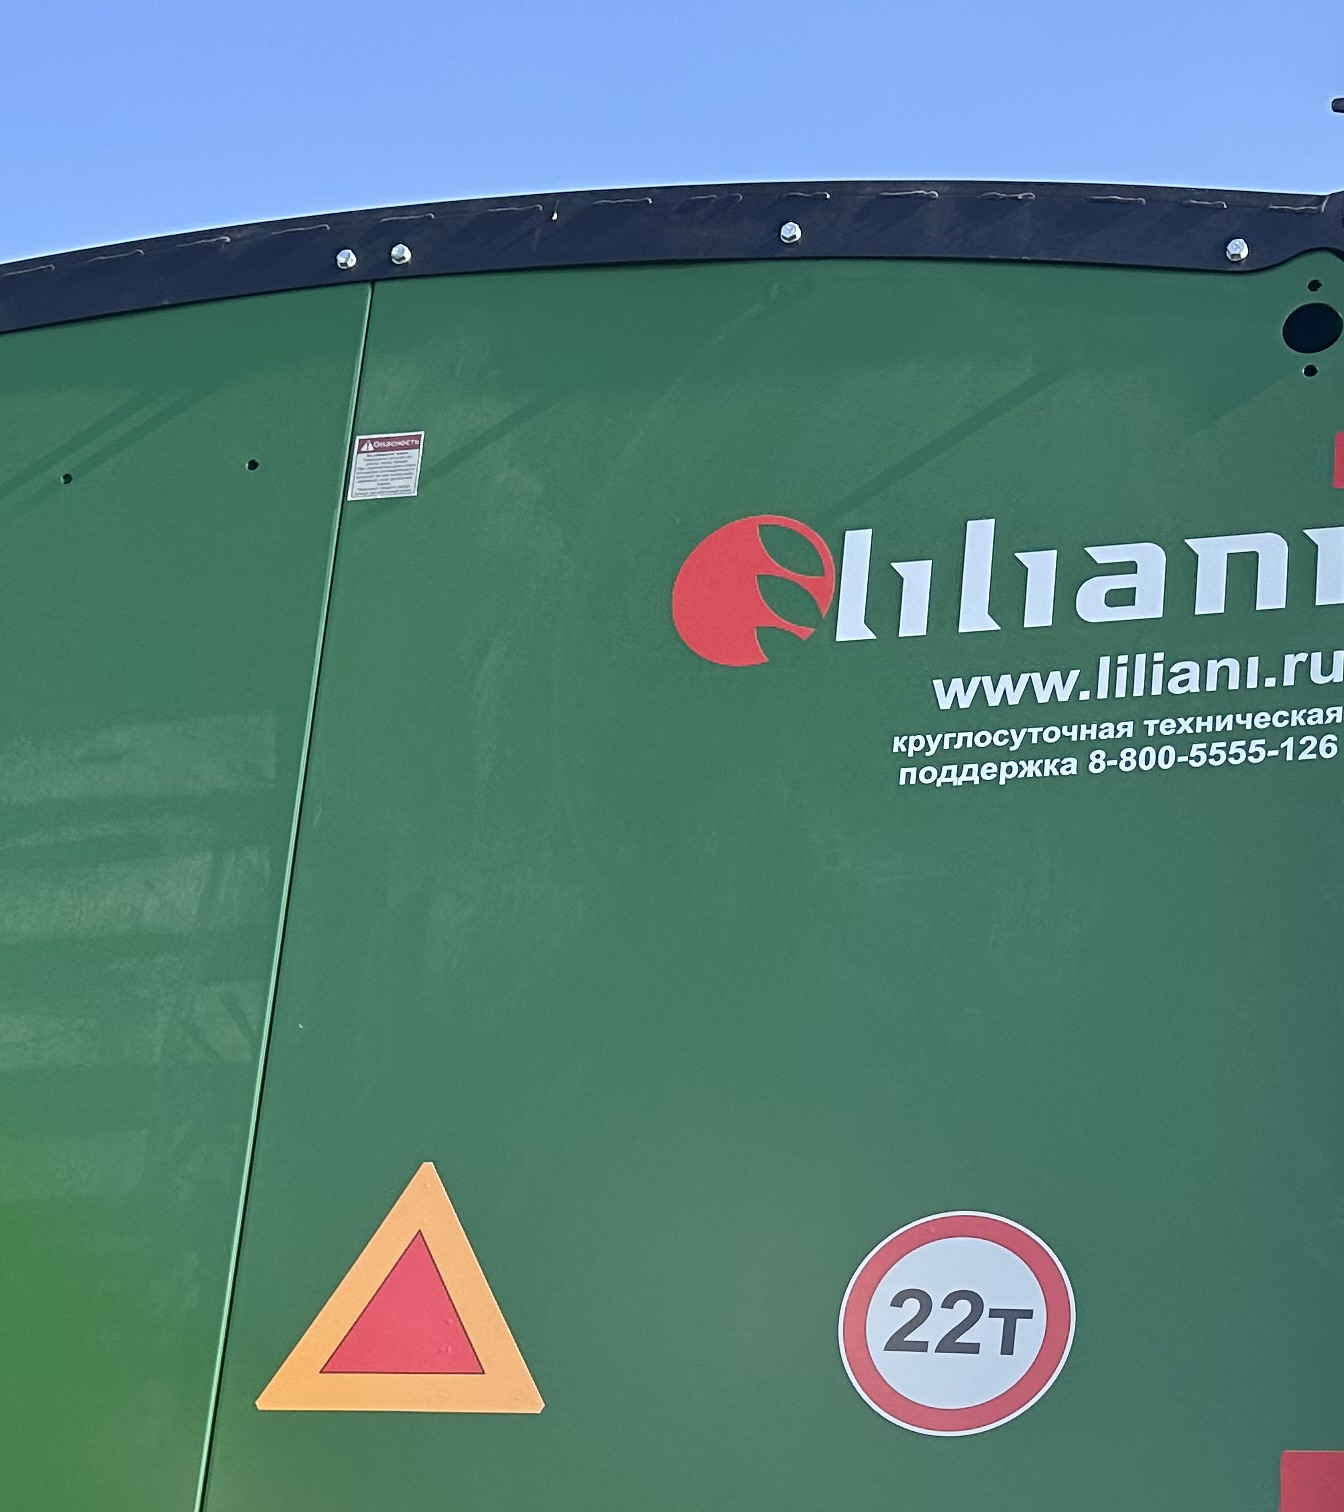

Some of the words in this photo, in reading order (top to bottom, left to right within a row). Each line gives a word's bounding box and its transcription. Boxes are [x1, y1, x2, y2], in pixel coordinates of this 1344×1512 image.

[892, 720, 1134, 758] круглосуточная
[1143, 705, 1344, 737] техническая
[898, 756, 1078, 788] поддержка
[1088, 733, 1339, 774] 8-800-5555-126
